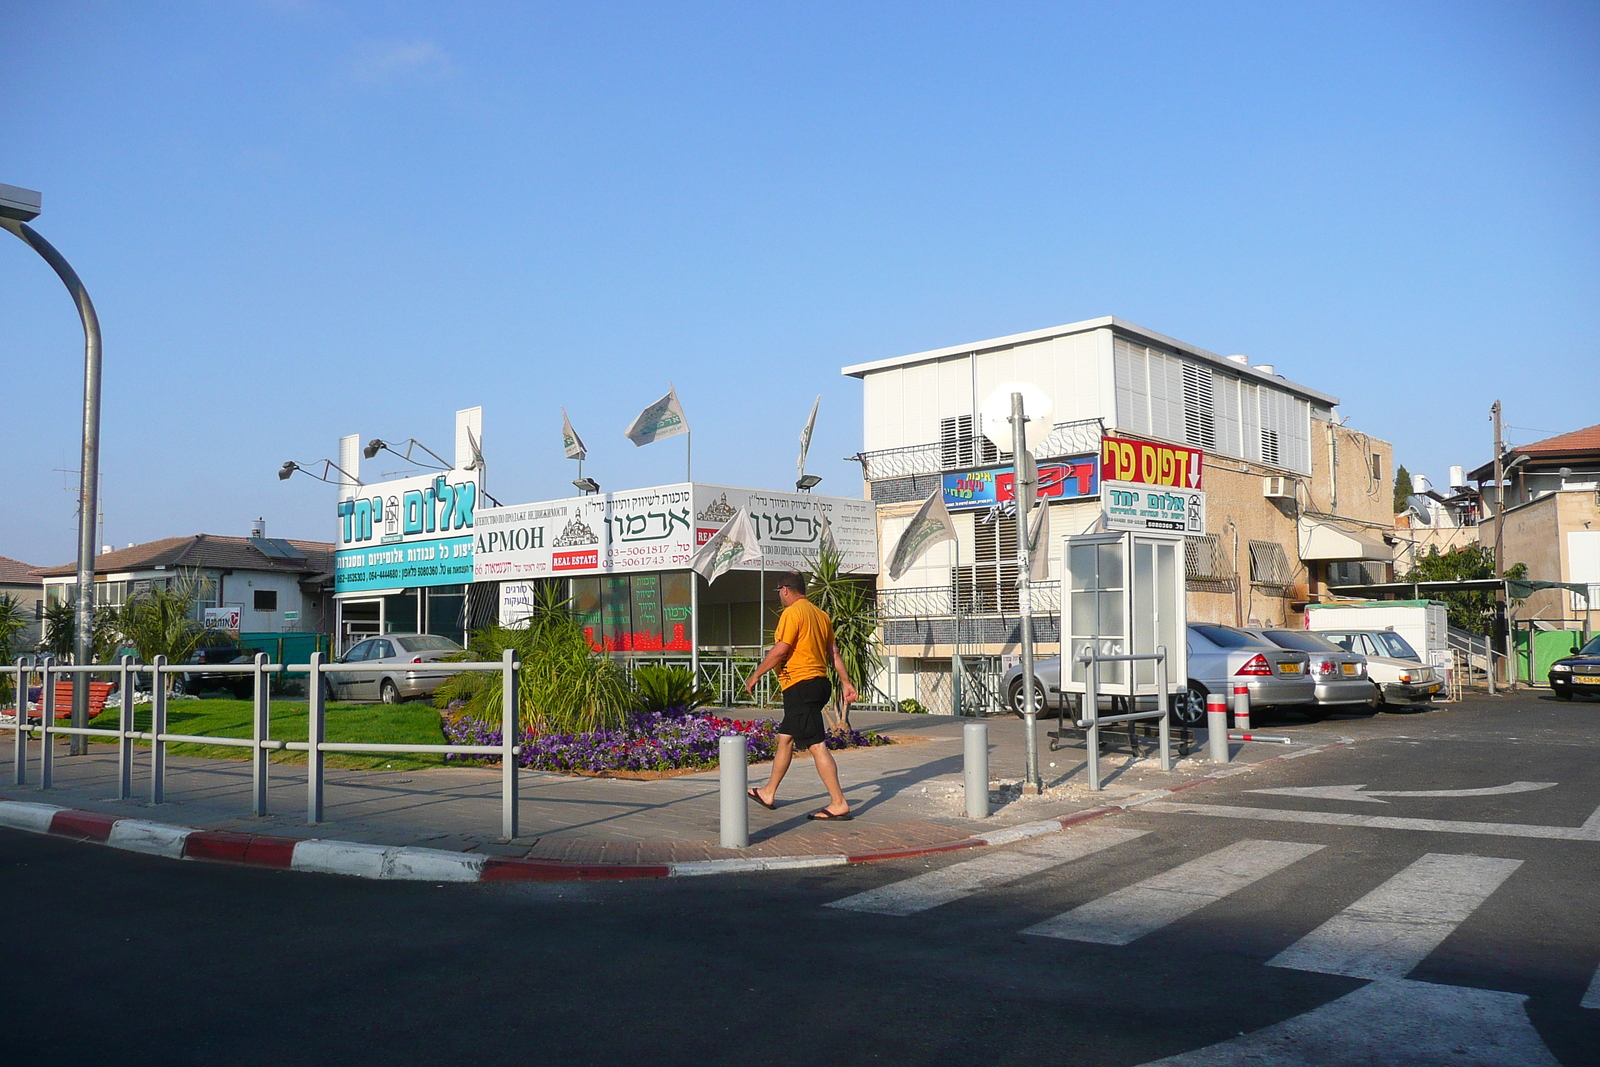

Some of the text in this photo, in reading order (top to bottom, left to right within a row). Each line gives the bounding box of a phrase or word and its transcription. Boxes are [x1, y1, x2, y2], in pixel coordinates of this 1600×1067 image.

[1103, 440, 1188, 487] דפוס פרי
[966, 472, 992, 482] איכות
[956, 479, 984, 492] עיצוב
[606, 498, 630, 514] ותיווך
[632, 489, 660, 511] לשיווק
[662, 491, 690, 505] סוכנות
[1110, 490, 1185, 512] אלום יחד
[337, 475, 475, 543] אלום יחד
[604, 506, 690, 546] ארמון
[475, 526, 545, 554] АРМОН
[368, 548, 404, 566] אלומיניום
[407, 546, 434, 562] עבודות
[439, 543, 449, 559] כל
[607, 544, 669, 557] 03-5061817
[337, 554, 365, 568] ומסגרות
[553, 554, 597, 566] REAL ESTATE
[602, 556, 665, 568] 03-5061743
[506, 585, 528, 594] סורגים
[663, 606, 692, 621] ארמון
